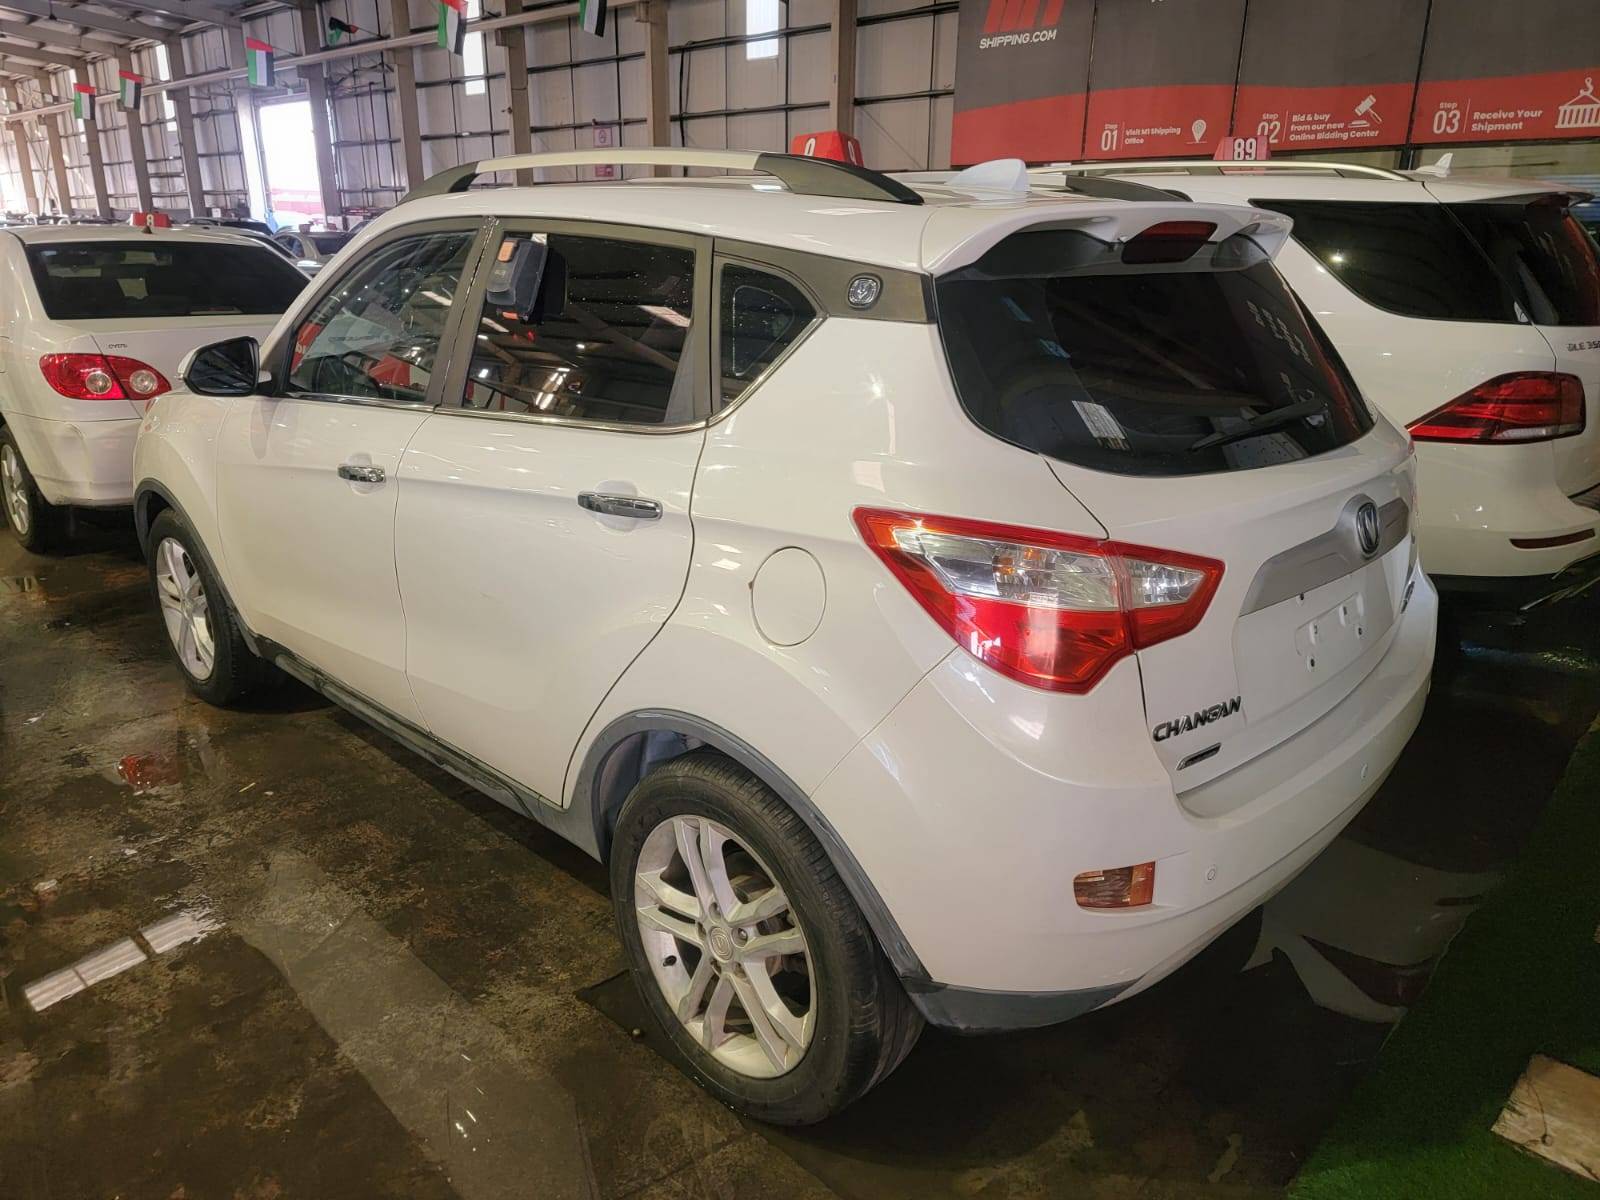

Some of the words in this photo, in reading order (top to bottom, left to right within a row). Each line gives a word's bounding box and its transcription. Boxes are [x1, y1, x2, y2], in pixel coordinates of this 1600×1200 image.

[979, 29, 1058, 49] SHIPPING.COM
[1439, 102, 1458, 110] Step
[1306, 113, 1313, 121] &
[1313, 113, 1331, 121] buy
[1473, 110, 1515, 120] Receive
[1517, 109, 1543, 118] Your
[1433, 110, 1461, 134] 03
[1471, 121, 1523, 133] Shipment
[1151, 126, 1181, 136] Shipping
[1289, 132, 1316, 141] Online
[1317, 131, 1349, 141] Bidding
[1350, 129, 1379, 138] Center
[1101, 129, 1118, 152] 01
[1233, 138, 1257, 160] 89
[1152, 696, 1241, 742] CHANGAN
